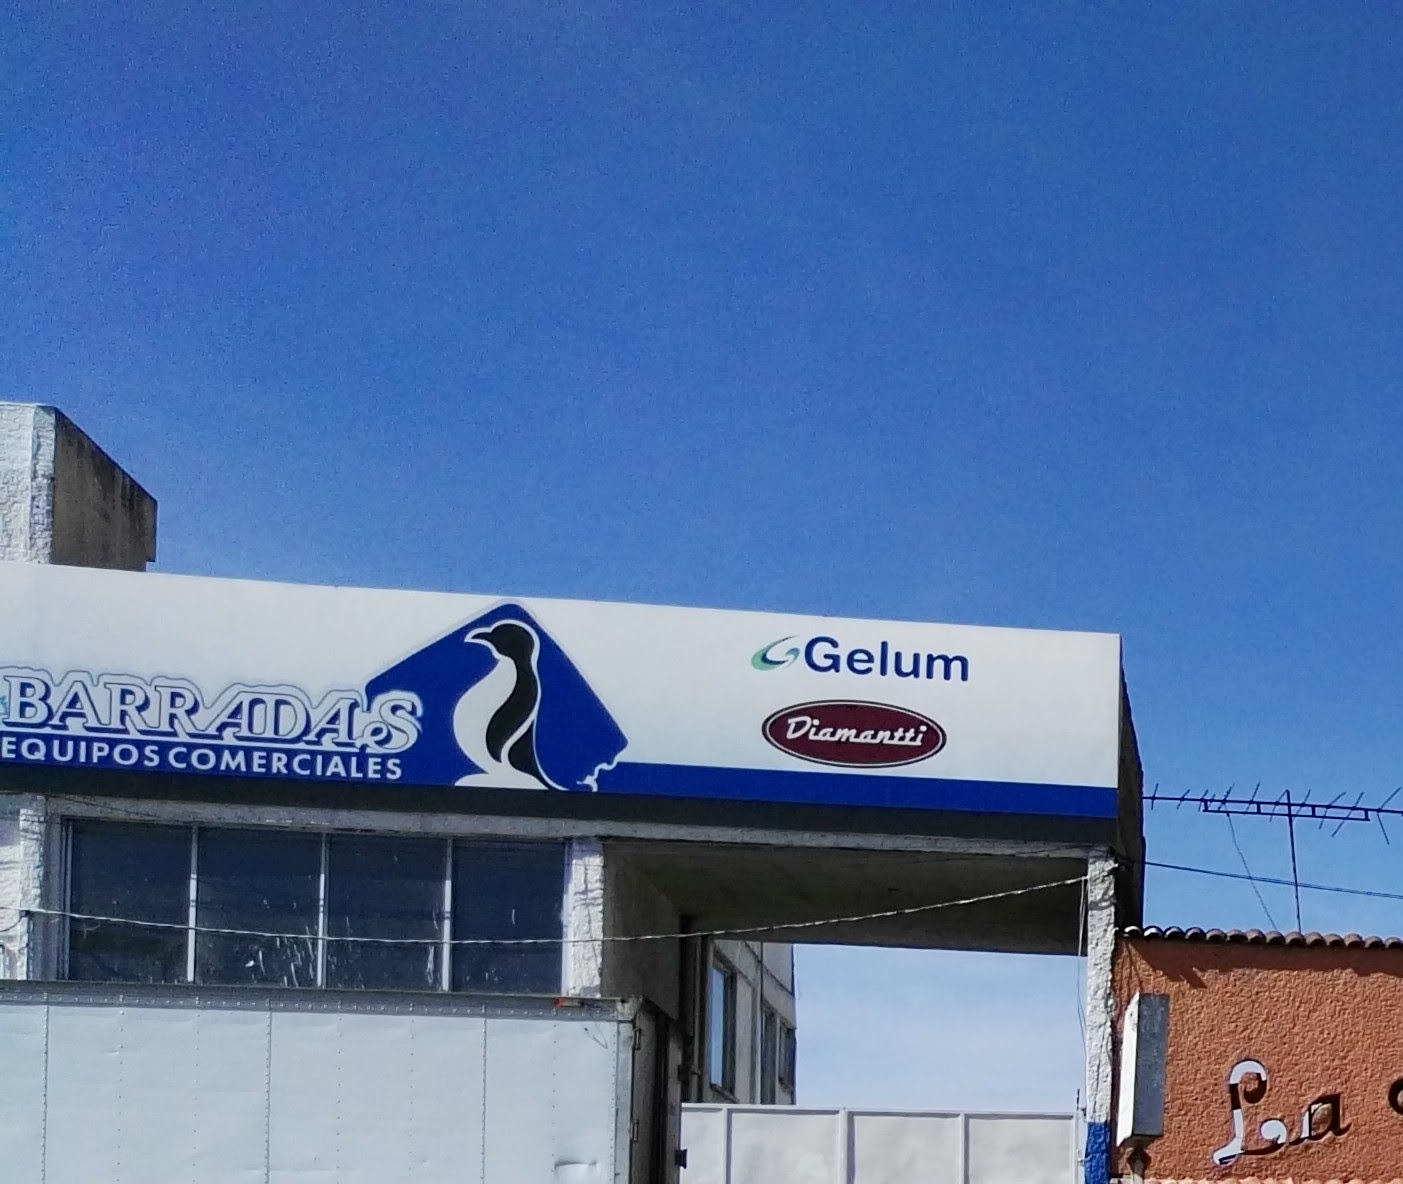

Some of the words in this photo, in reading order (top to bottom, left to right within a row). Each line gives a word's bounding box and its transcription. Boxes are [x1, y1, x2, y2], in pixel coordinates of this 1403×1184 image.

[804, 636, 968, 681] Gelum
[3, 675, 421, 753] BARRADAS
[786, 716, 927, 746] Diamantti
[2, 736, 160, 768] EQUIPOS
[169, 746, 402, 780] COMERCIALES
[1213, 1058, 1352, 1165] La
